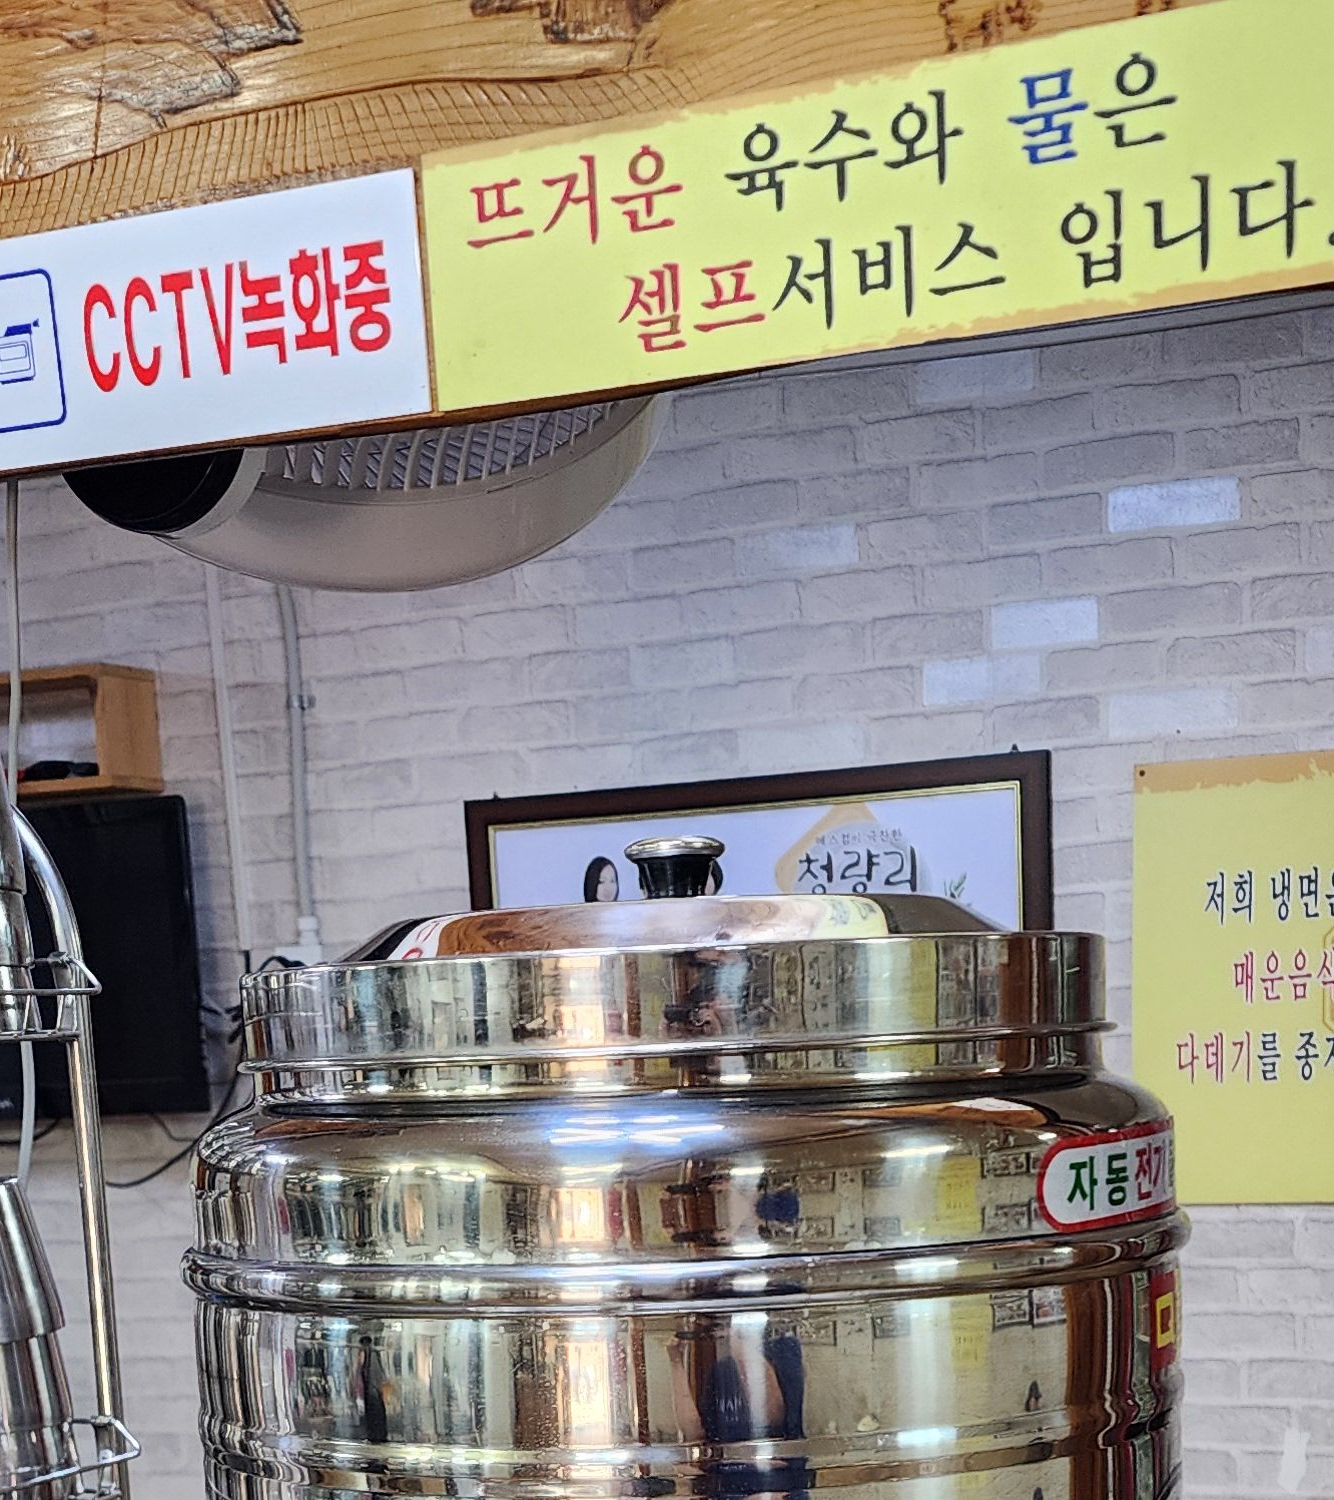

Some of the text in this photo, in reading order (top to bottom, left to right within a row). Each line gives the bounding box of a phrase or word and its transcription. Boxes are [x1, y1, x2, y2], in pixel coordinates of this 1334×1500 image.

[468, 51, 1177, 251] 뜨거운 육수와 물은
[618, 222, 1006, 354] 셀프서비스
[798, 845, 917, 894] 청량리
[1204, 866, 1253, 926] 저희
[1176, 1030, 1281, 1084] 다데기를
